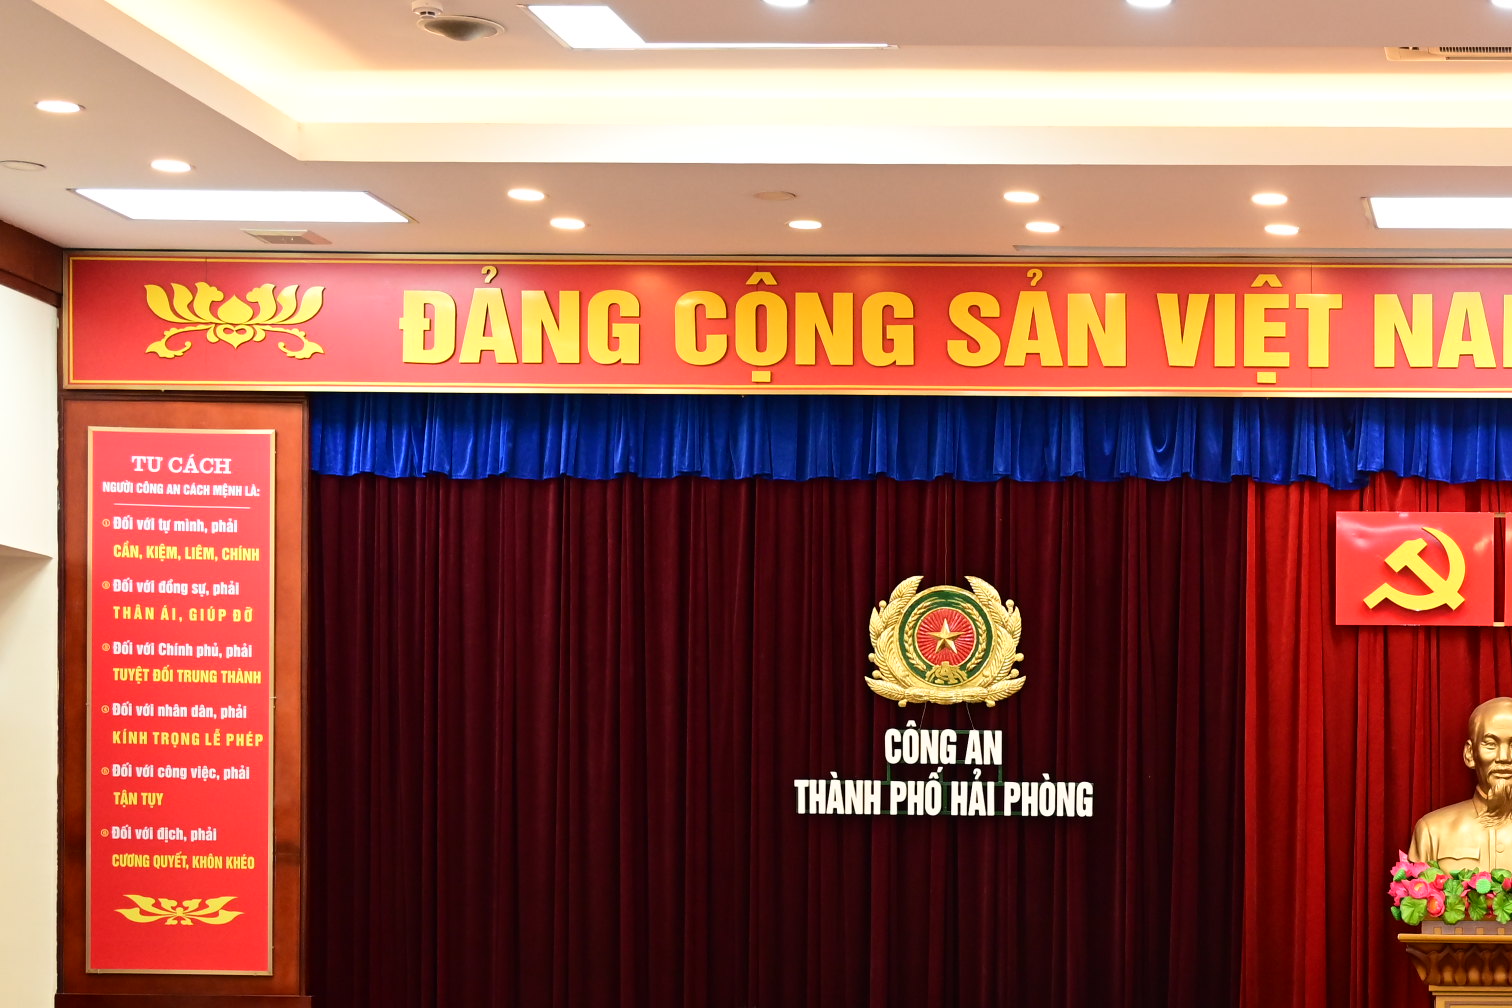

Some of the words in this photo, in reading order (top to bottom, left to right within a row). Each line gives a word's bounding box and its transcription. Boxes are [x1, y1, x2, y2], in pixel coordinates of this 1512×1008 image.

[401, 266, 639, 365] ĐẢNG
[676, 272, 914, 382] CỘNG
[948, 268, 1126, 367] SẢN
[1158, 274, 1342, 384] VIỆT
[132, 456, 163, 472] TƯ
[168, 454, 232, 474] CÁCH
[103, 480, 133, 493] NGƯỜI
[136, 481, 163, 494] CÔNG
[166, 484, 180, 494] AN
[184, 483, 210, 495] CÁCH
[213, 483, 242, 498] MỆNH
[245, 484, 260, 496] LÀ:
[113, 515, 133, 530] Đối
[137, 518, 154, 530] với
[158, 518, 171, 534] tự
[174, 519, 208, 533] mình,
[212, 518, 237, 534] phải
[146, 544, 181, 561] KIỆM,
[185, 544, 218, 561] LIÊM,
[222, 546, 259, 561] CHÍNH
[113, 729, 147, 744] KÍNH
[153, 732, 199, 748] TRỌNG
[206, 730, 220, 746] LỄ
[226, 731, 263, 746] PHÉP
[885, 720, 956, 764] CÔNG
[965, 730, 1002, 764] AN
[114, 790, 137, 807] TẬN
[141, 793, 163, 808] TỤY
[794, 772, 881, 814] THÀNH
[890, 769, 942, 815] PHỐ
[951, 769, 994, 816] HẢI
[1004, 774, 1093, 816] PHÒNG
